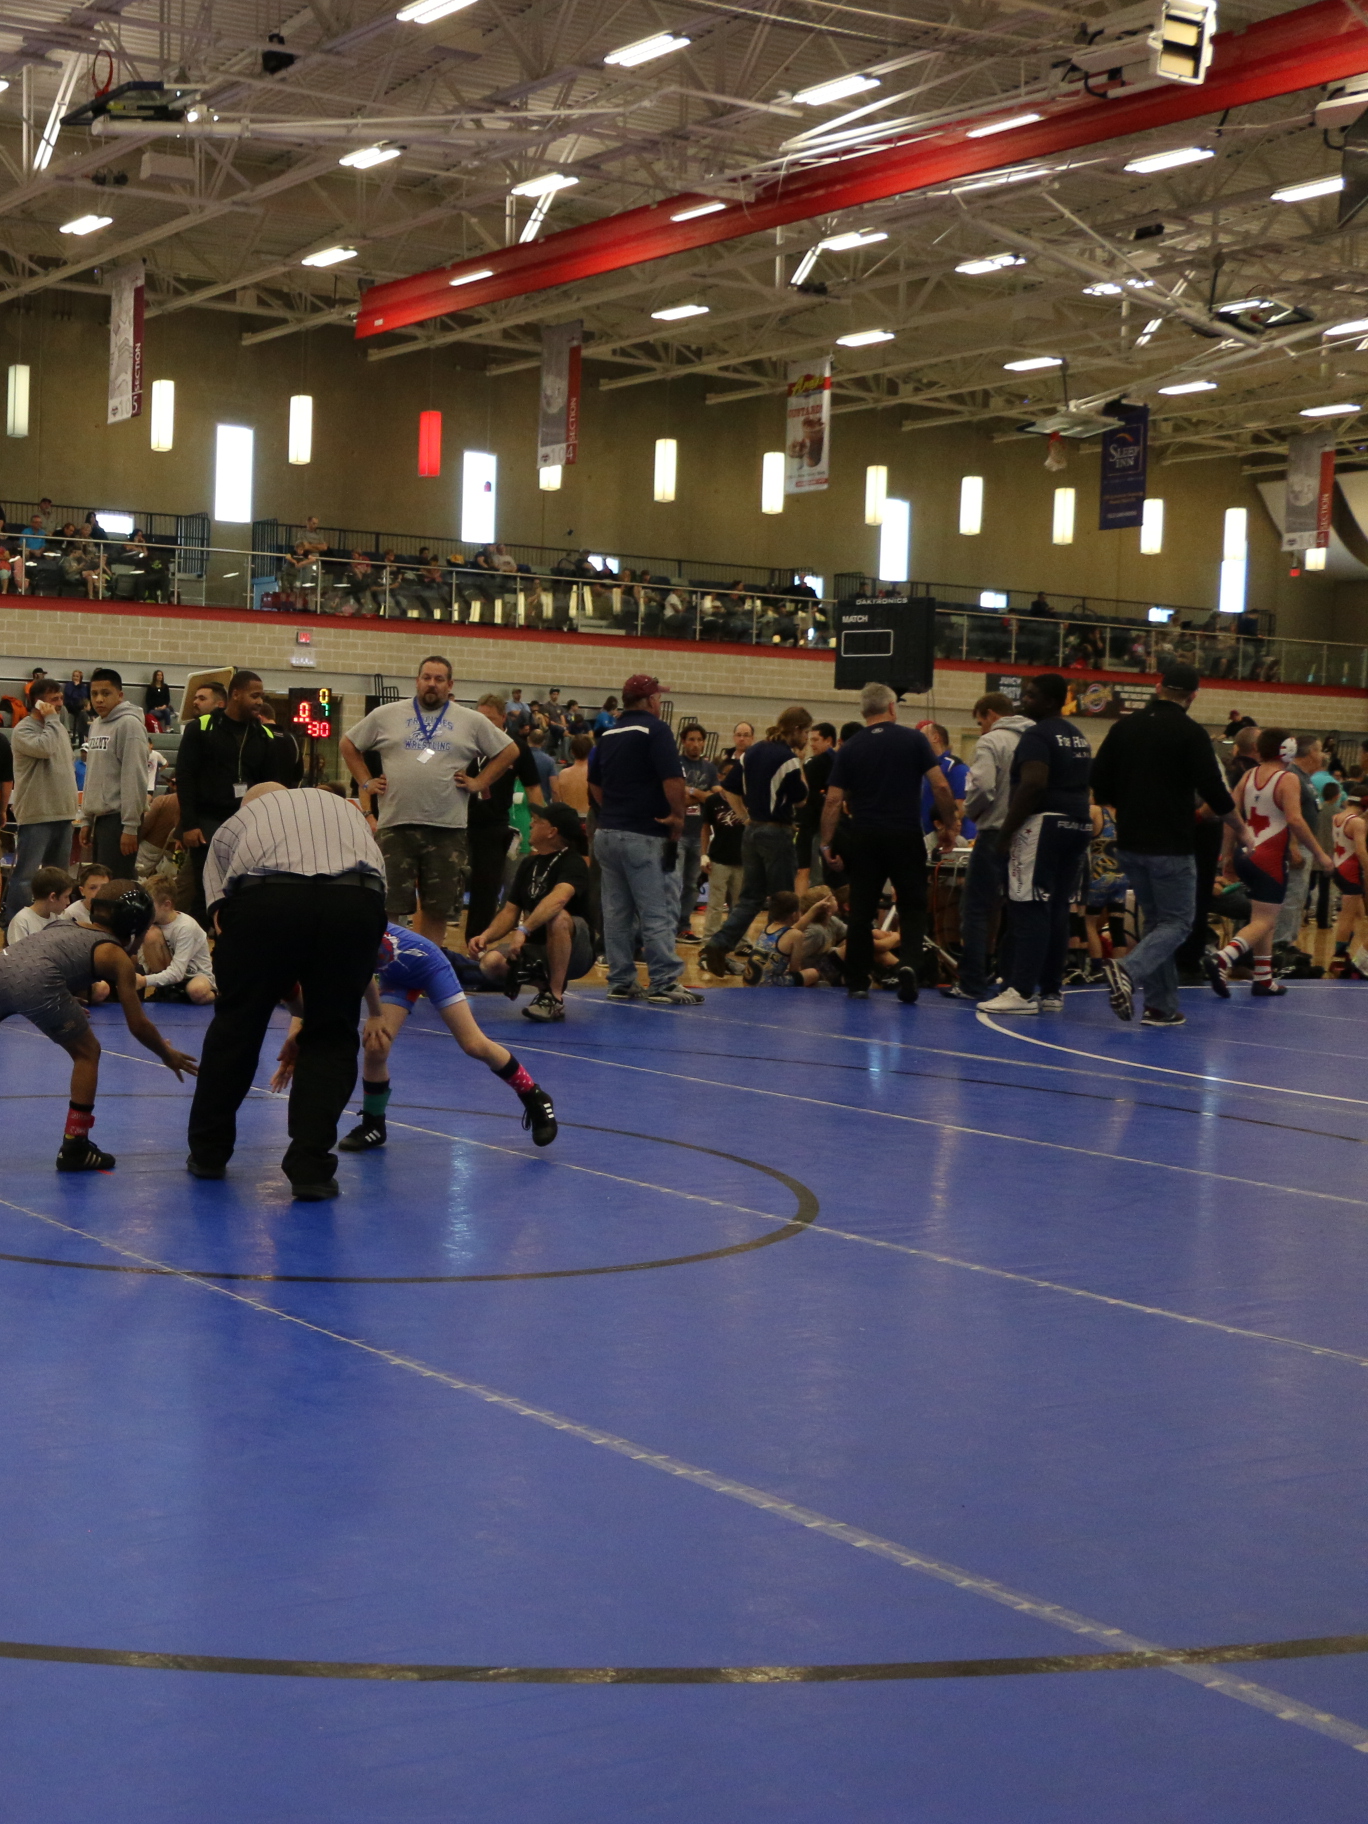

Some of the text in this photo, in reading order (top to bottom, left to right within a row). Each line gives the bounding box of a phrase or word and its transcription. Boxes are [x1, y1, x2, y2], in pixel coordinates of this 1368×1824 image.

[134, 342, 142, 392] SECTION
[568, 397, 578, 443] SECTION
[1115, 457, 1135, 469] INN
[855, 597, 908, 605] DAKTRONICS
[842, 615, 868, 623] MATCH
[319, 688, 329, 704] 0
[299, 702, 329, 718] 0 7
[405, 740, 451, 750] WRESTLING
